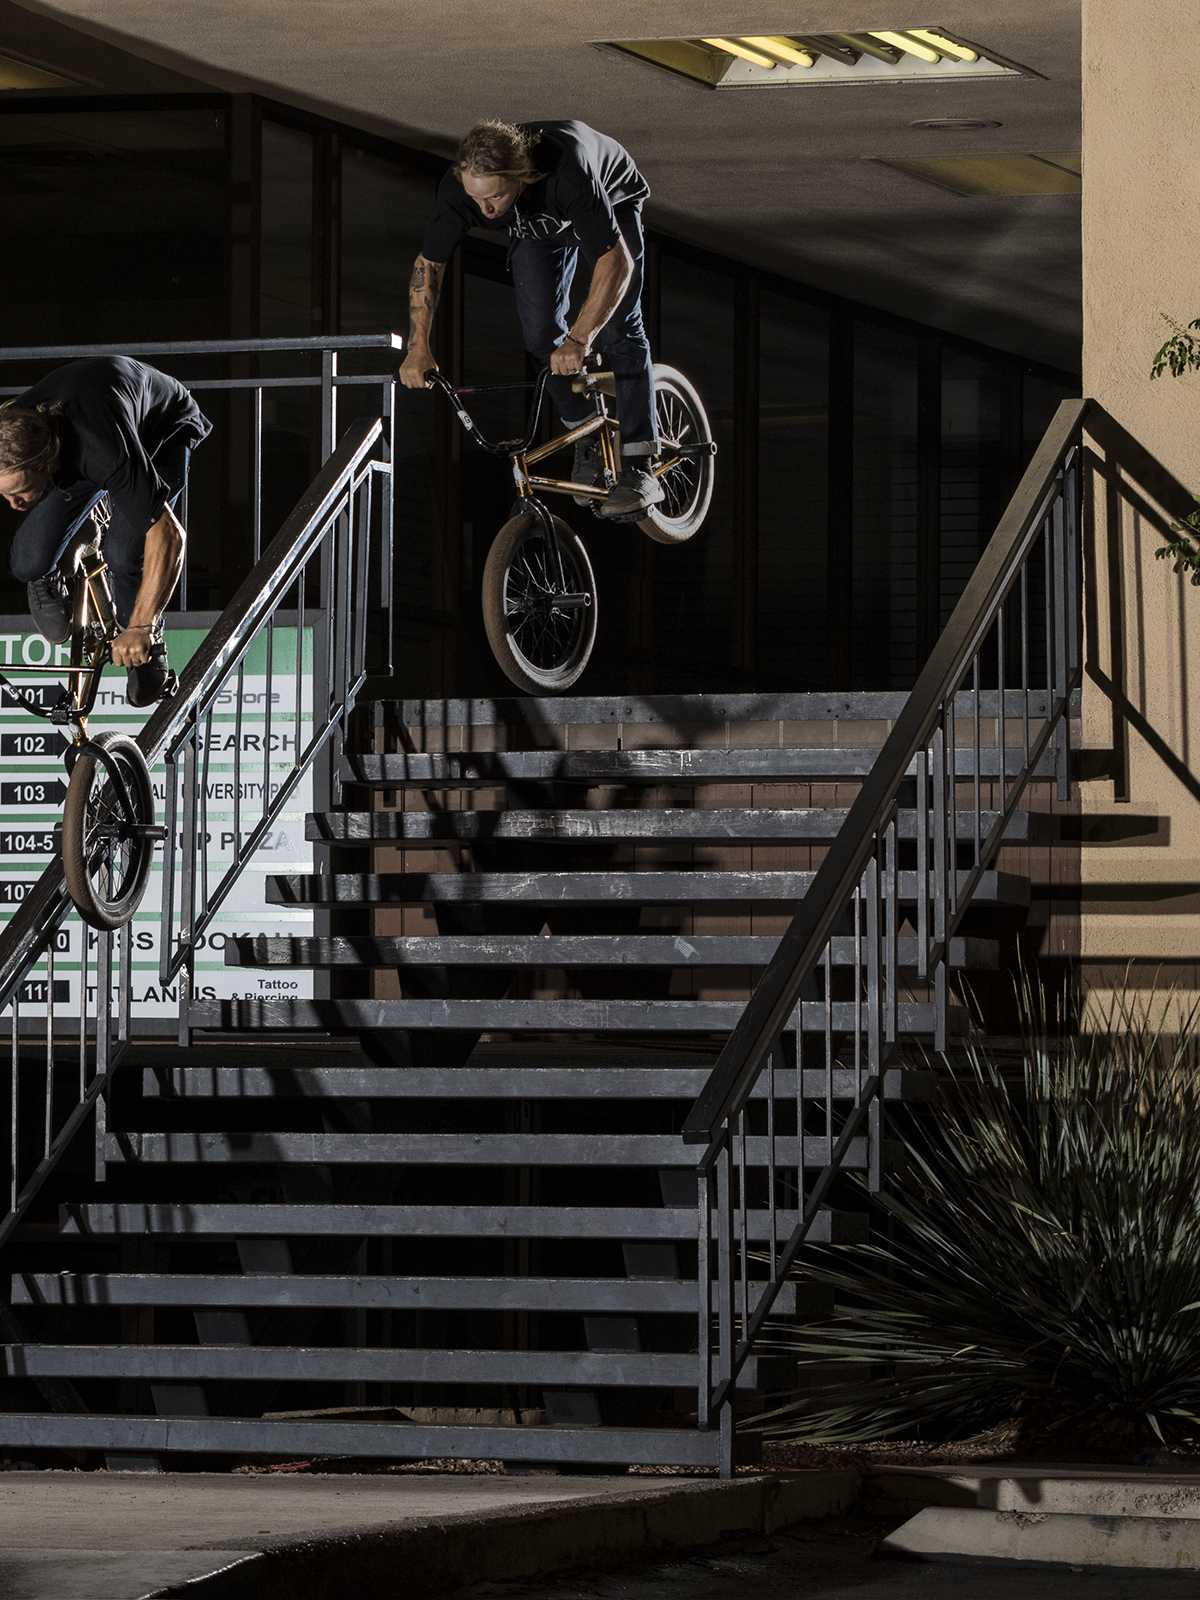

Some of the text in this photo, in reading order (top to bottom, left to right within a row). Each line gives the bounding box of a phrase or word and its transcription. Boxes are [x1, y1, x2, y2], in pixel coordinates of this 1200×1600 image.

[14, 688, 44, 705] 01
[96, 691, 134, 706] Th
[13, 736, 45, 754] 102
[13, 784, 45, 802] 103
[181, 783, 267, 800] VERSITY
[4, 834, 54, 851] 104-5
[257, 979, 298, 989] Tattoo
[85, 986, 216, 1003] TTLANIS
